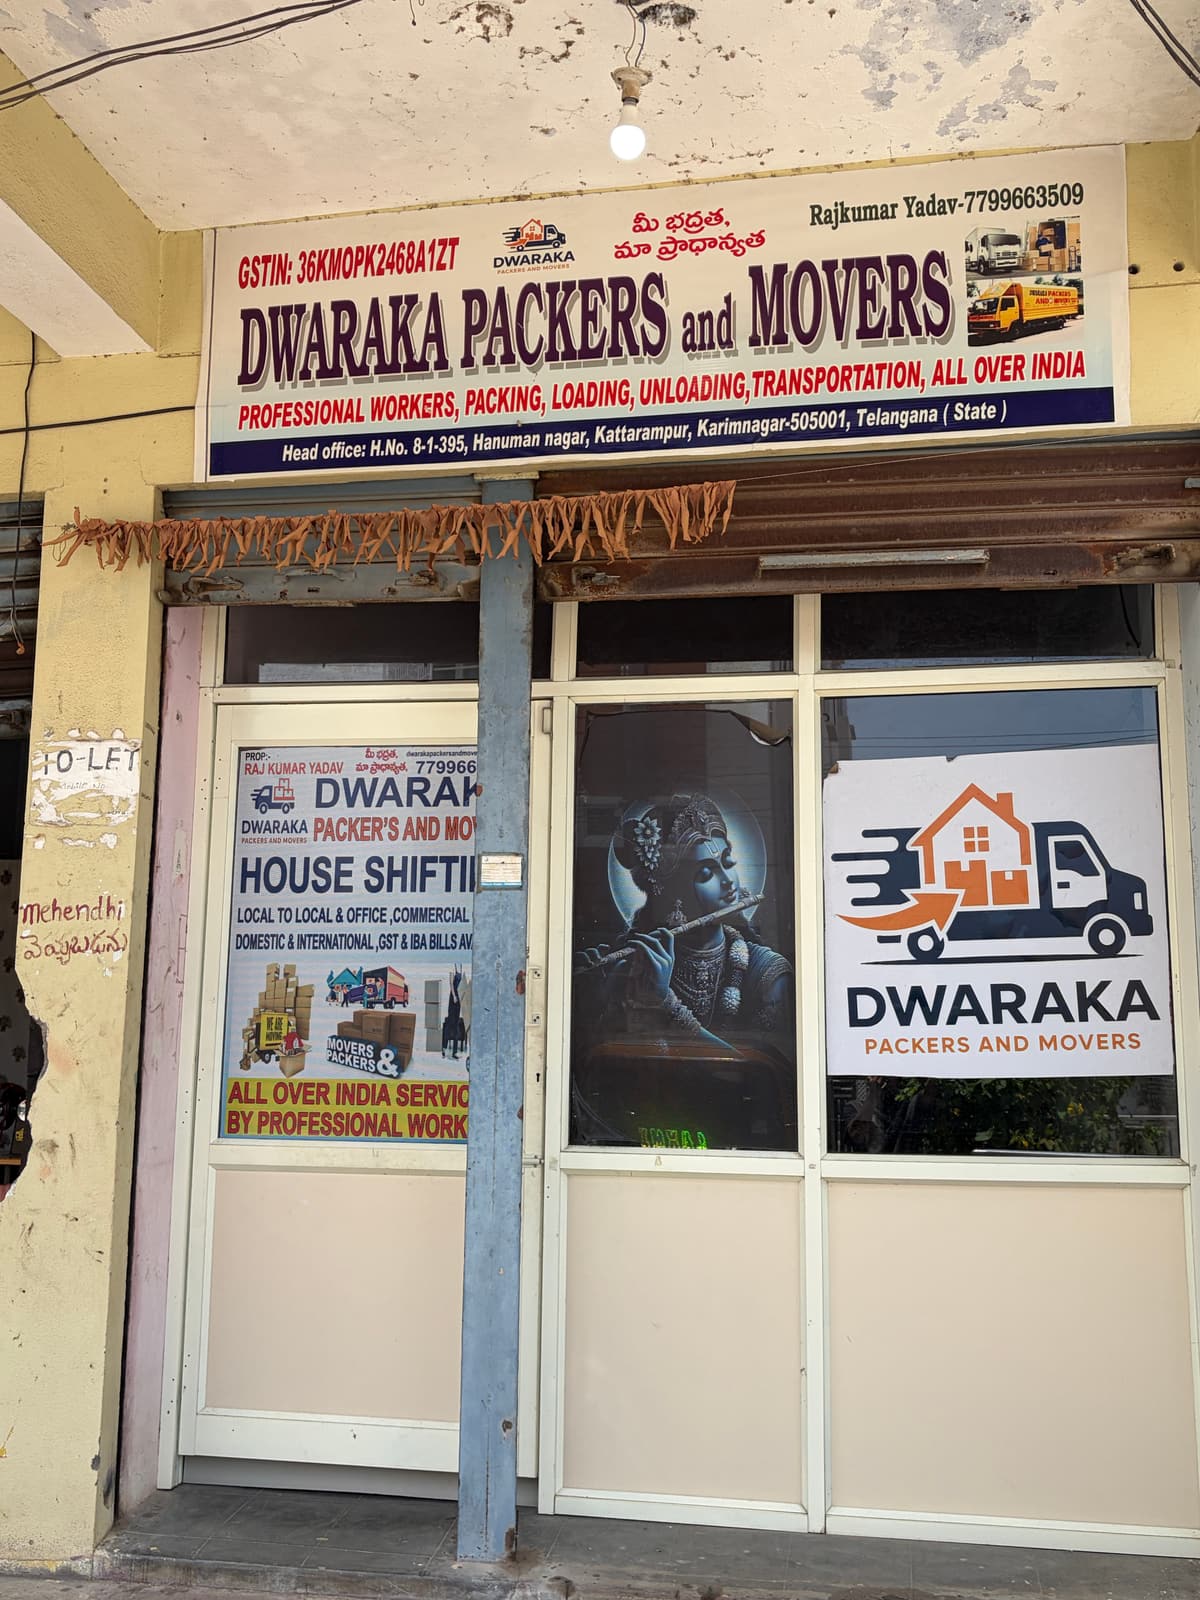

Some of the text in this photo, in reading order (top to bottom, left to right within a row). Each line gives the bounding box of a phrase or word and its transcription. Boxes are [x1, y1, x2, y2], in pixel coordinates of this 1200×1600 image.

[632, 212, 660, 233] మీ
[810, 201, 899, 230] Rajkumar
[614, 229, 766, 261] మా ప్రాధాన్యత
[238, 253, 293, 289] GSTIN:
[493, 250, 576, 268] DWARAKA
[497, 267, 526, 275] PACKERS
[542, 263, 570, 271] MOVERS
[238, 250, 952, 387] DWARAKA PACKERS and MOVERS
[238, 398, 365, 430] PROFESSIONAL
[370, 391, 460, 423] WORKERS,
[465, 385, 546, 419] PACKING,
[552, 379, 635, 412] LOADING,
[931, 358, 967, 386] ALL
[974, 355, 1025, 383] OVER
[1031, 351, 1086, 380] INDIA
[282, 444, 320, 462] Head
[322, 441, 366, 459] office:
[370, 439, 408, 457] H.No.
[413, 435, 468, 456] 8-1-395,
[473, 432, 540, 451] Hanuman
[544, 431, 590, 450] nagar,
[594, 423, 692, 447] Kattarampur,
[697, 409, 851, 437] Karimnagar-505001,
[857, 407, 938, 429] Telangana
[244, 762, 344, 776] RAJ KUMAR YADAV
[416, 760, 476, 774] 779966
[241, 819, 308, 834] DWARAKA
[313, 816, 399, 842] PACKER'S
[402, 816, 440, 841] AND
[240, 856, 354, 894] HOUSE
[237, 908, 275, 923] LOCAL
[278, 908, 293, 923] TO
[296, 908, 333, 923] LOCAL
[335, 908, 343, 923] &
[346, 907, 387, 923] OFFICE
[236, 934, 285, 950] DOMESTIC
[287, 934, 294, 950] &
[297, 934, 374, 950] INTERNATIONAL
[401, 934, 408, 950] &
[410, 934, 427, 950] IBA
[430, 934, 457, 950] BILLS
[459, 934, 473, 950] AV
[847, 979, 1160, 1028] DWARAKA
[327, 1038, 374, 1058] MOVERS
[865, 1032, 1141, 1055] PACKERS AND MOVERS
[327, 1049, 398, 1077] PACKERS &
[228, 1081, 268, 1105] ALL
[273, 1081, 330, 1106] OVER
[336, 1083, 391, 1106] INDIA
[227, 1110, 468, 1138] BY PROFESSIONAL WORK
